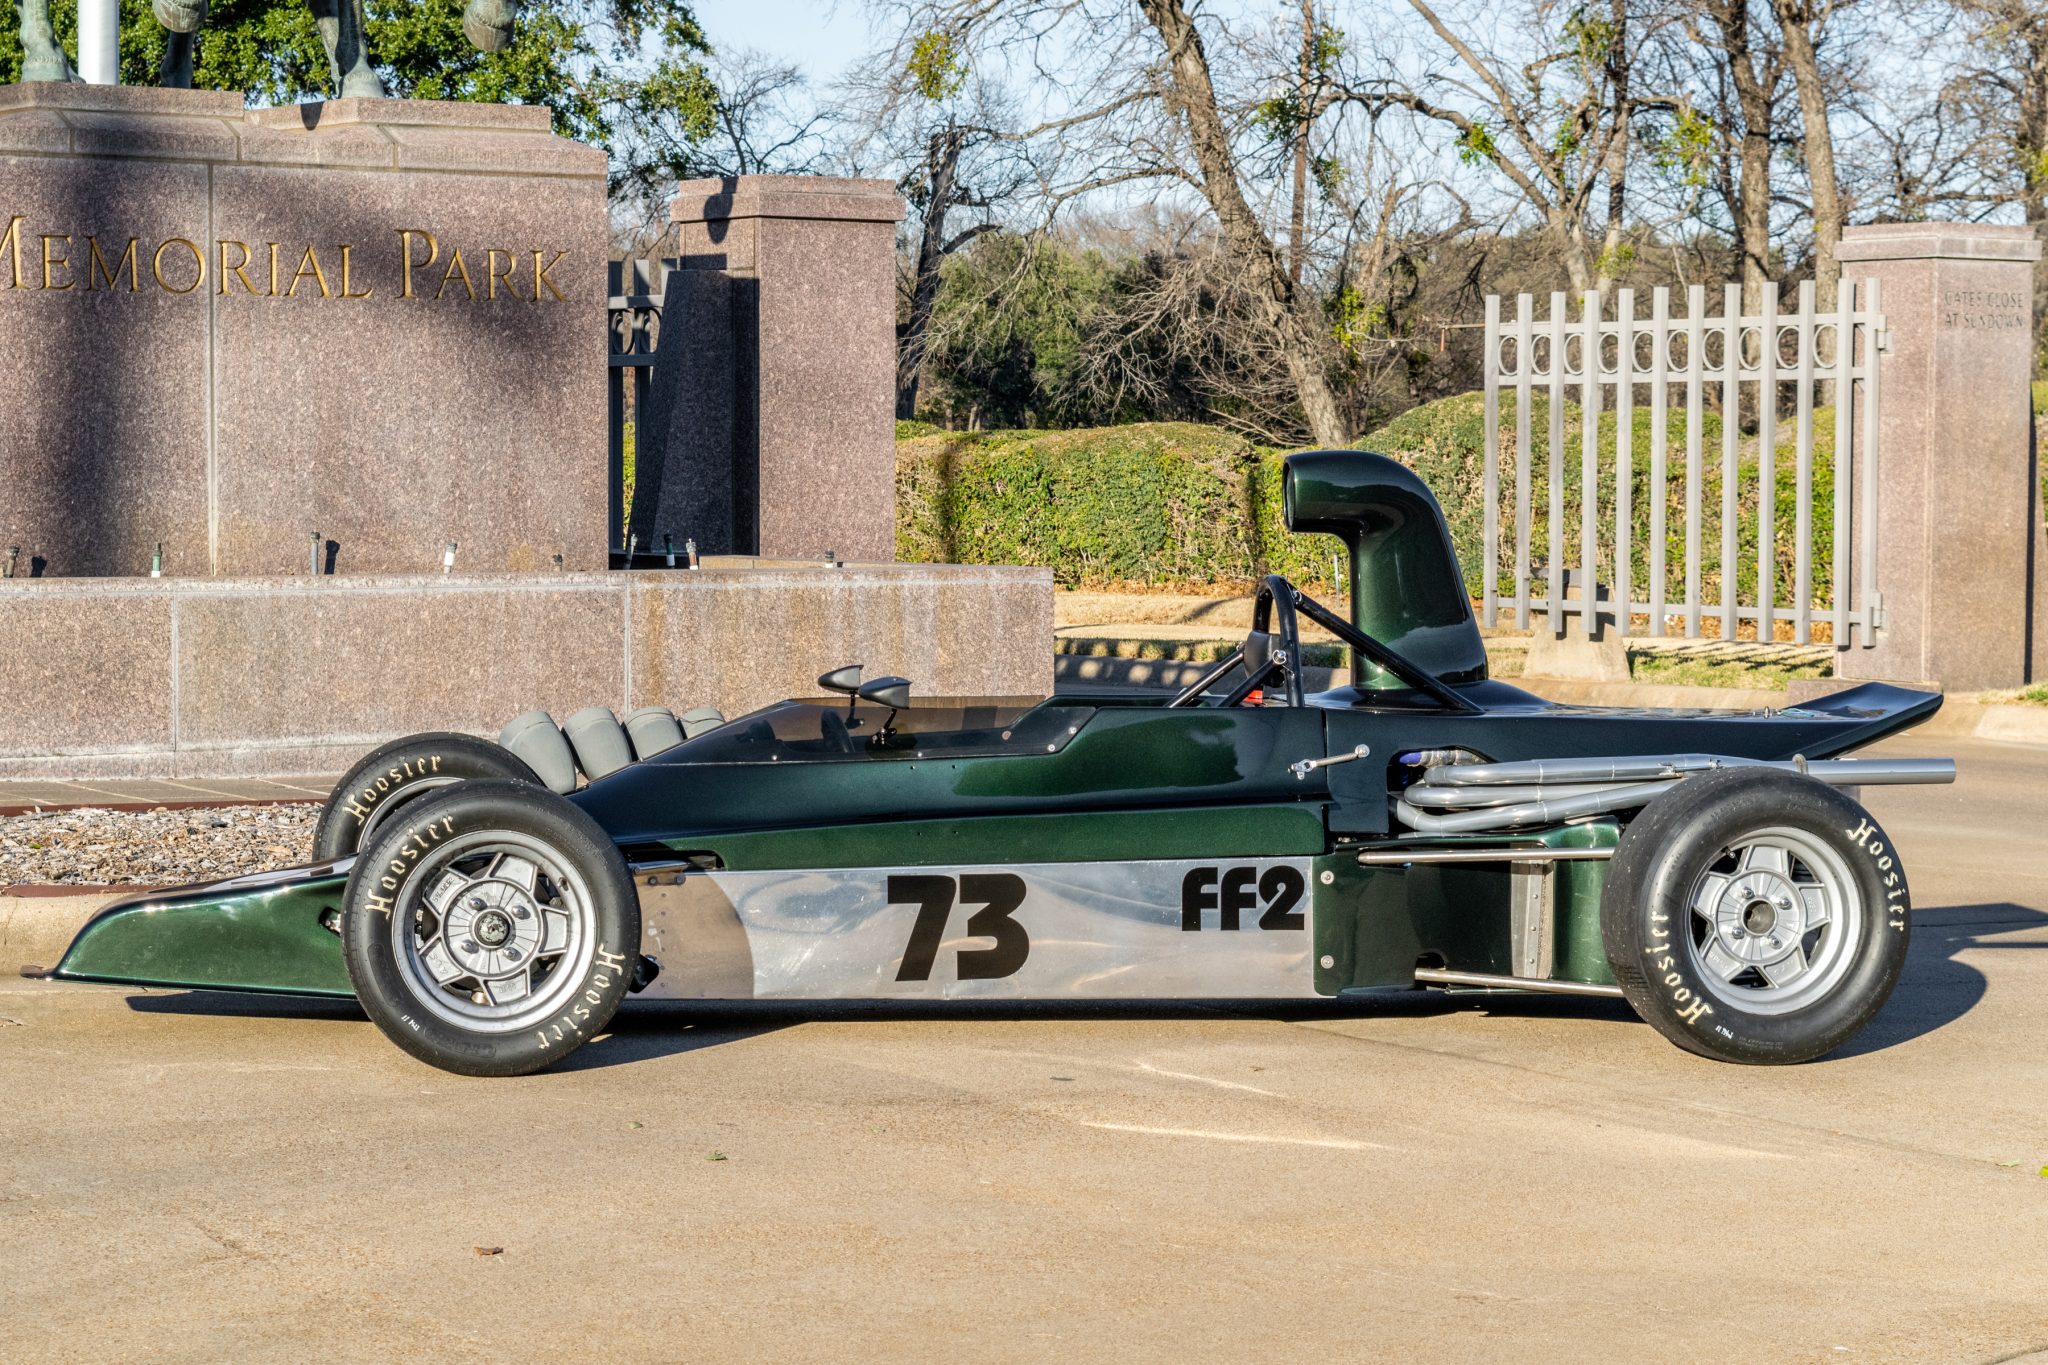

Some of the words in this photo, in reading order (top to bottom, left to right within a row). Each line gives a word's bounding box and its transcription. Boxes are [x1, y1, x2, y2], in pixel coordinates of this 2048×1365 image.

[394, 229, 570, 302] PARK
[1987, 292, 2023, 308] CLOSE
[1945, 313, 1959, 328] AT
[344, 754, 442, 826] Hoosier
[364, 815, 455, 920] Hoosier
[1181, 865, 1305, 931] FF2
[1847, 818, 1907, 932] Hoosier
[887, 873, 1030, 982] 73
[1645, 911, 1714, 1025] Hoosier
[538, 942, 626, 1050] Hoosier
